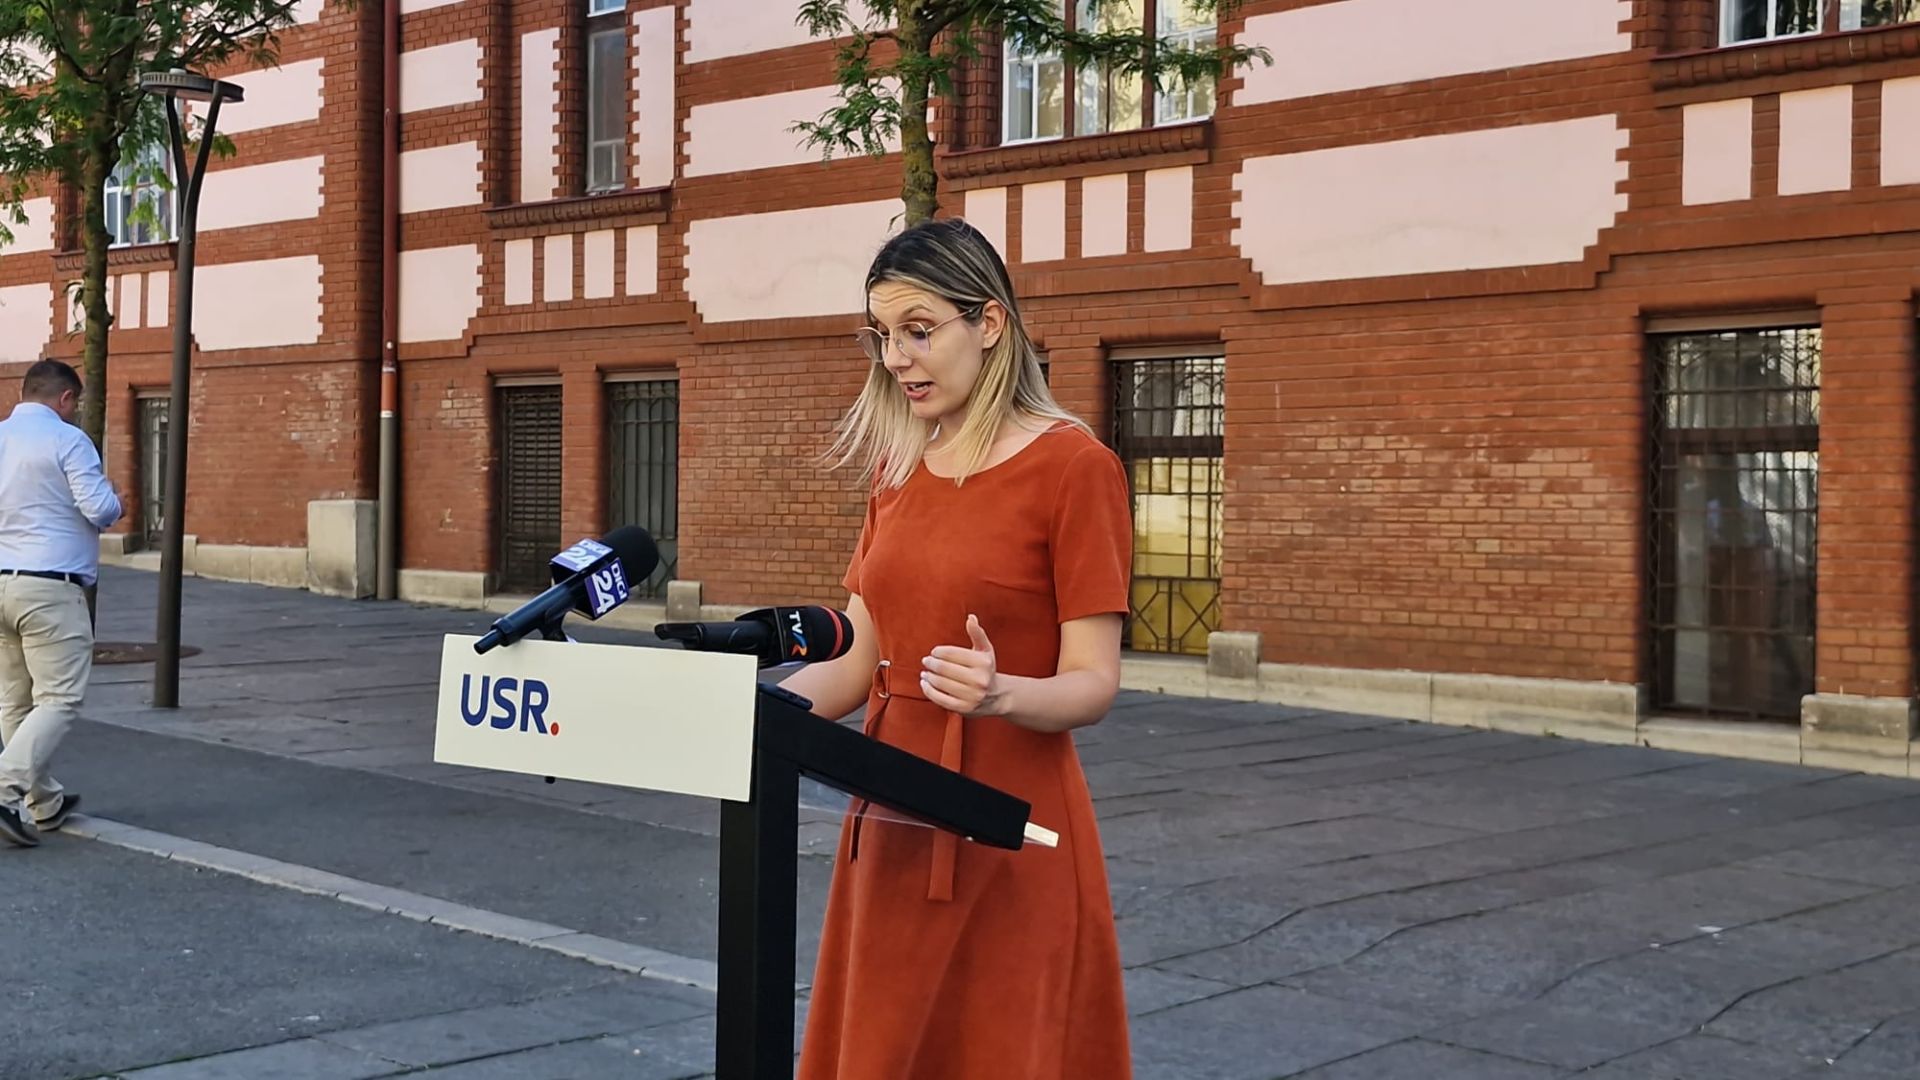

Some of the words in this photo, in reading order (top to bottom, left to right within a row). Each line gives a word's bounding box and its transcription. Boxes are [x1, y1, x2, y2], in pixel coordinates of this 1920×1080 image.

[560, 546, 599, 570] 24
[591, 570, 616, 615] 24
[610, 562, 629, 600] DIGI
